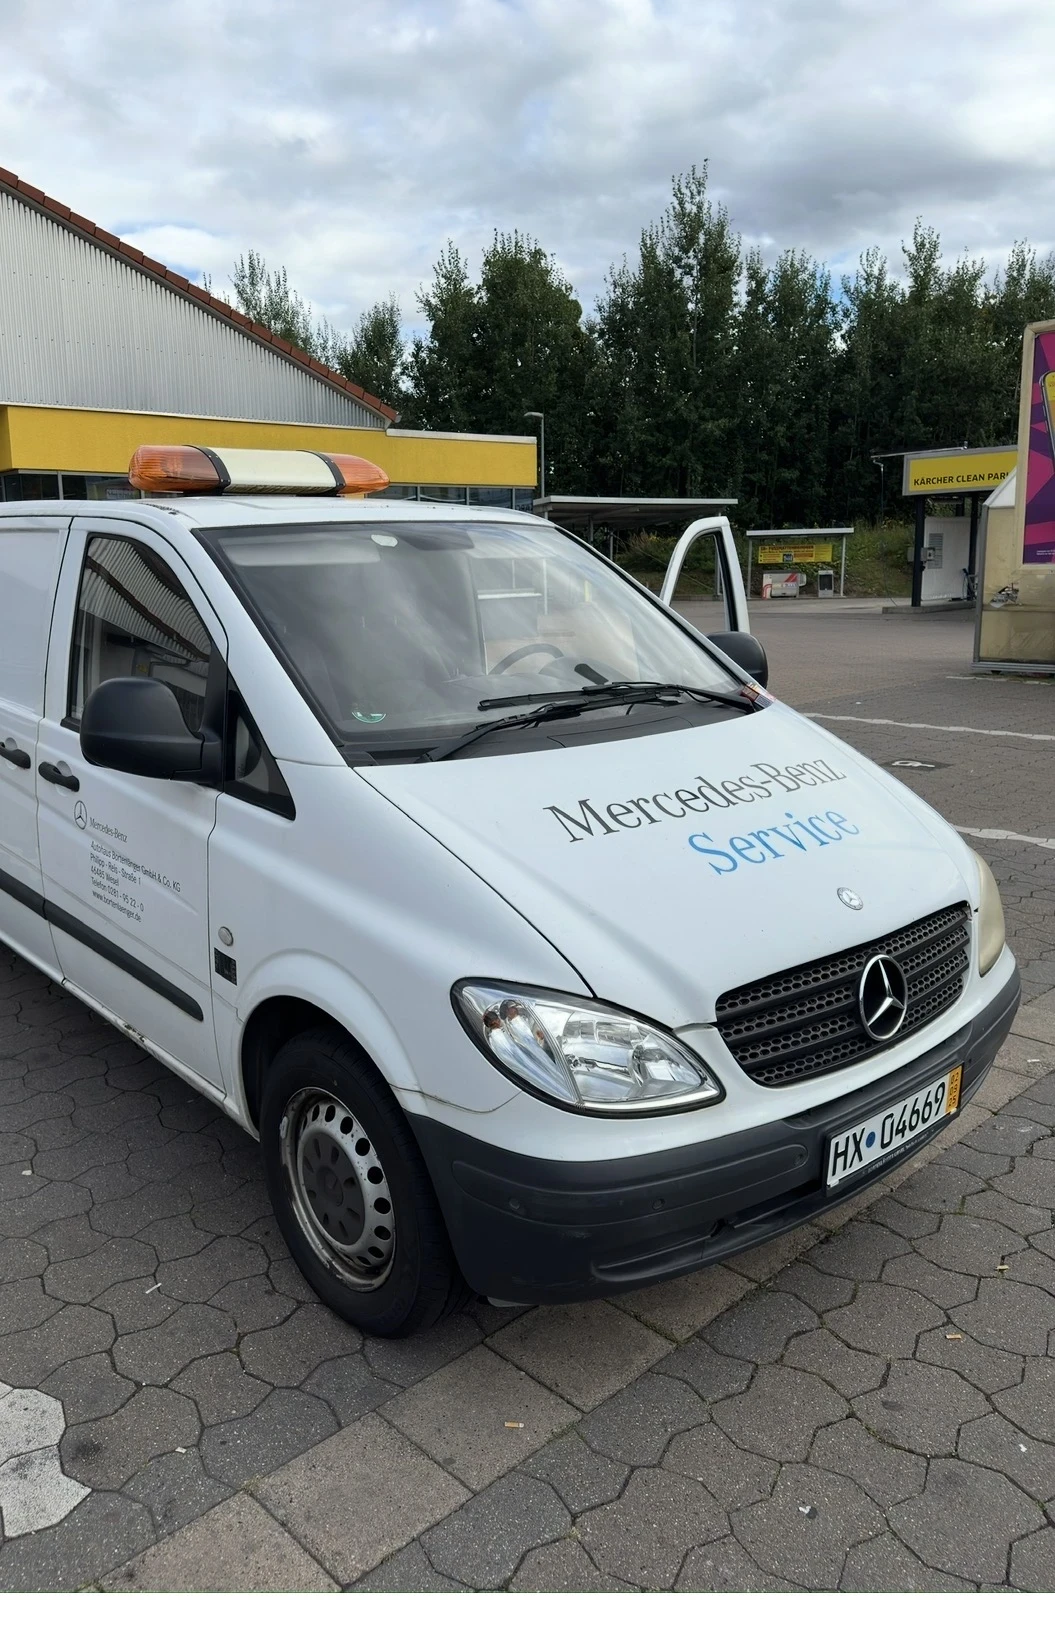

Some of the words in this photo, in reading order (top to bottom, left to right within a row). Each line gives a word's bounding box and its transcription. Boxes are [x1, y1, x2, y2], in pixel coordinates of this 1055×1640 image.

[913, 475, 954, 486] KÄRCHER
[956, 473, 985, 483] CLEAN
[543, 758, 847, 843] Mercedes-Benz
[89, 817, 128, 843] Mercedes-Benz
[688, 810, 861, 876] Service
[90, 841, 111, 858] Autohaus
[141, 865, 157, 881] GmbH
[162, 876, 172, 889] Co.
[172, 880, 181, 893] KG
[90, 853, 105, 868] Philipp
[108, 862, 118, 874] Reis
[120, 868, 137, 883] Straße
[105, 873, 120, 887] Wesel
[91, 876, 107, 891] Telefon
[831, 1127, 865, 1177] HX
[880, 1081, 946, 1150] 04669
